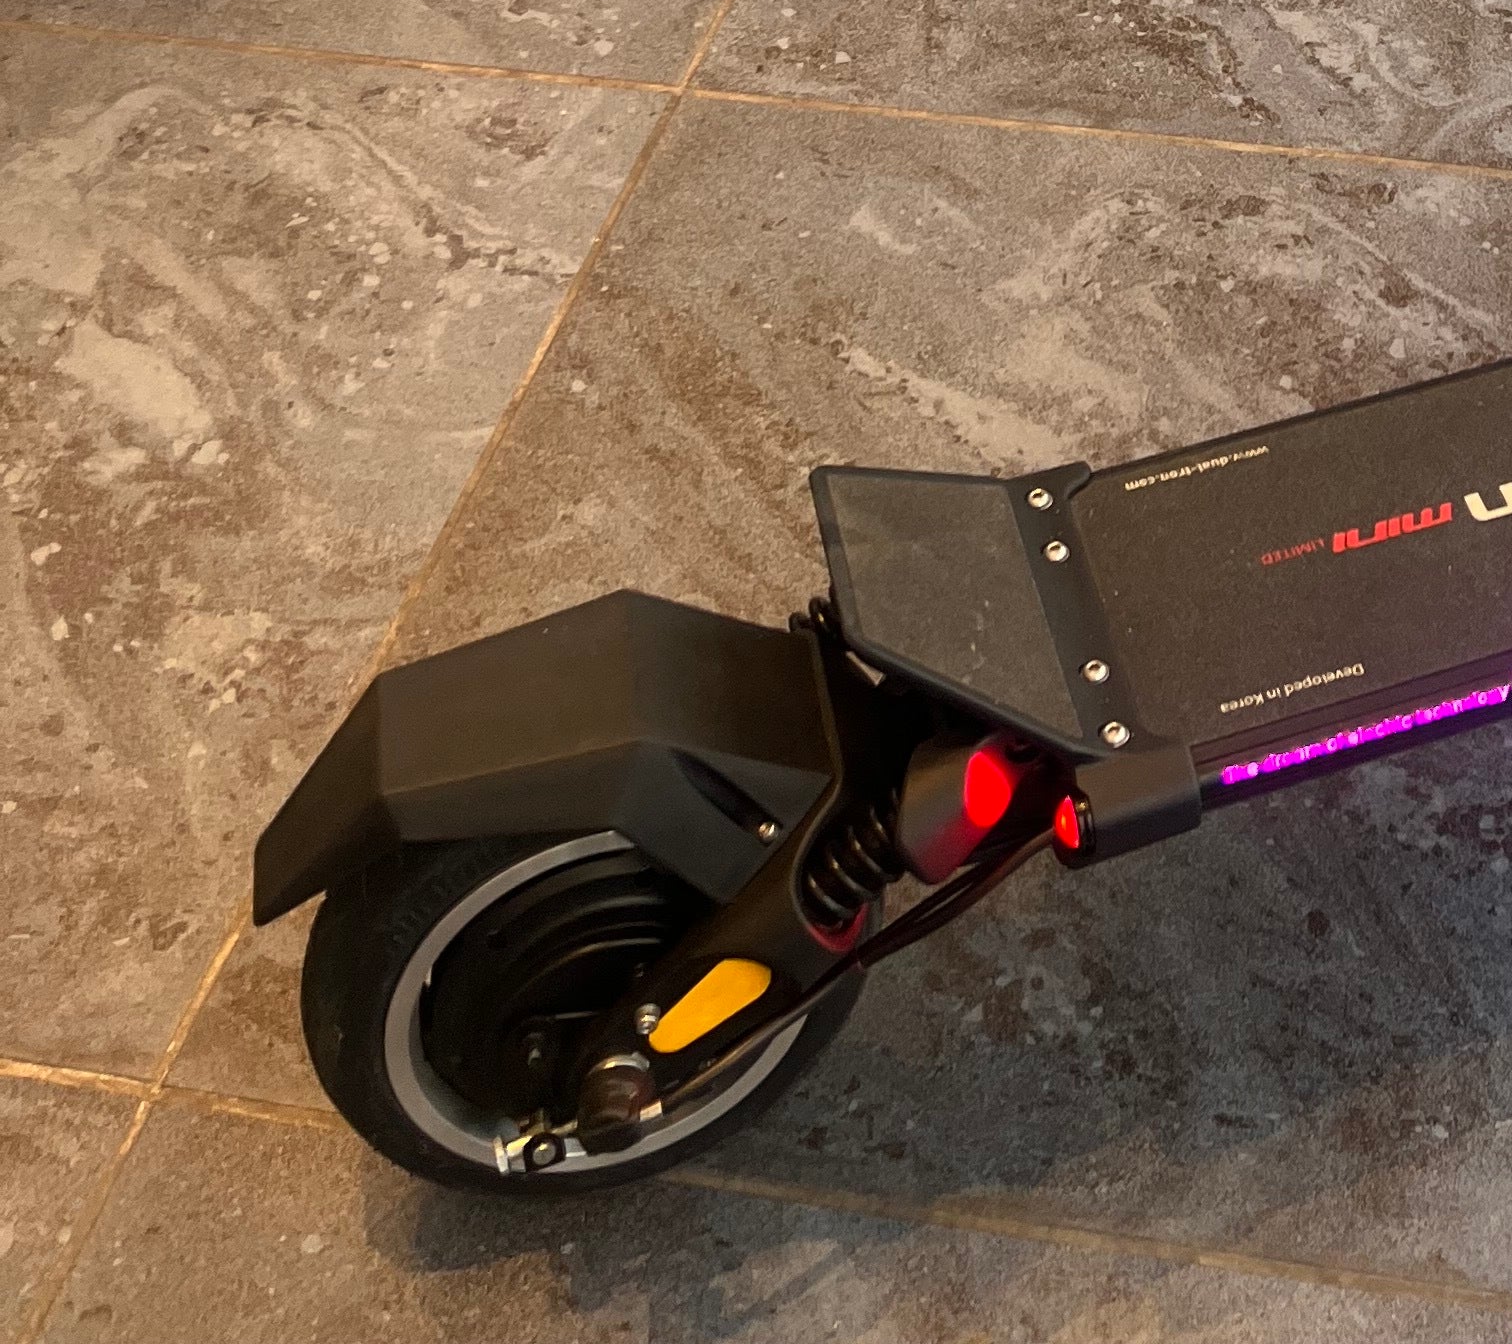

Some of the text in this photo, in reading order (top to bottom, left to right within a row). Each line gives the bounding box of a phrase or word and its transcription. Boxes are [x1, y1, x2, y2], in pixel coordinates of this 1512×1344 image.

[1125, 446, 1269, 491] www.dual-tron.com
[1261, 538, 1325, 567] LIMITED
[1221, 663, 1365, 713] Developed in Korea
